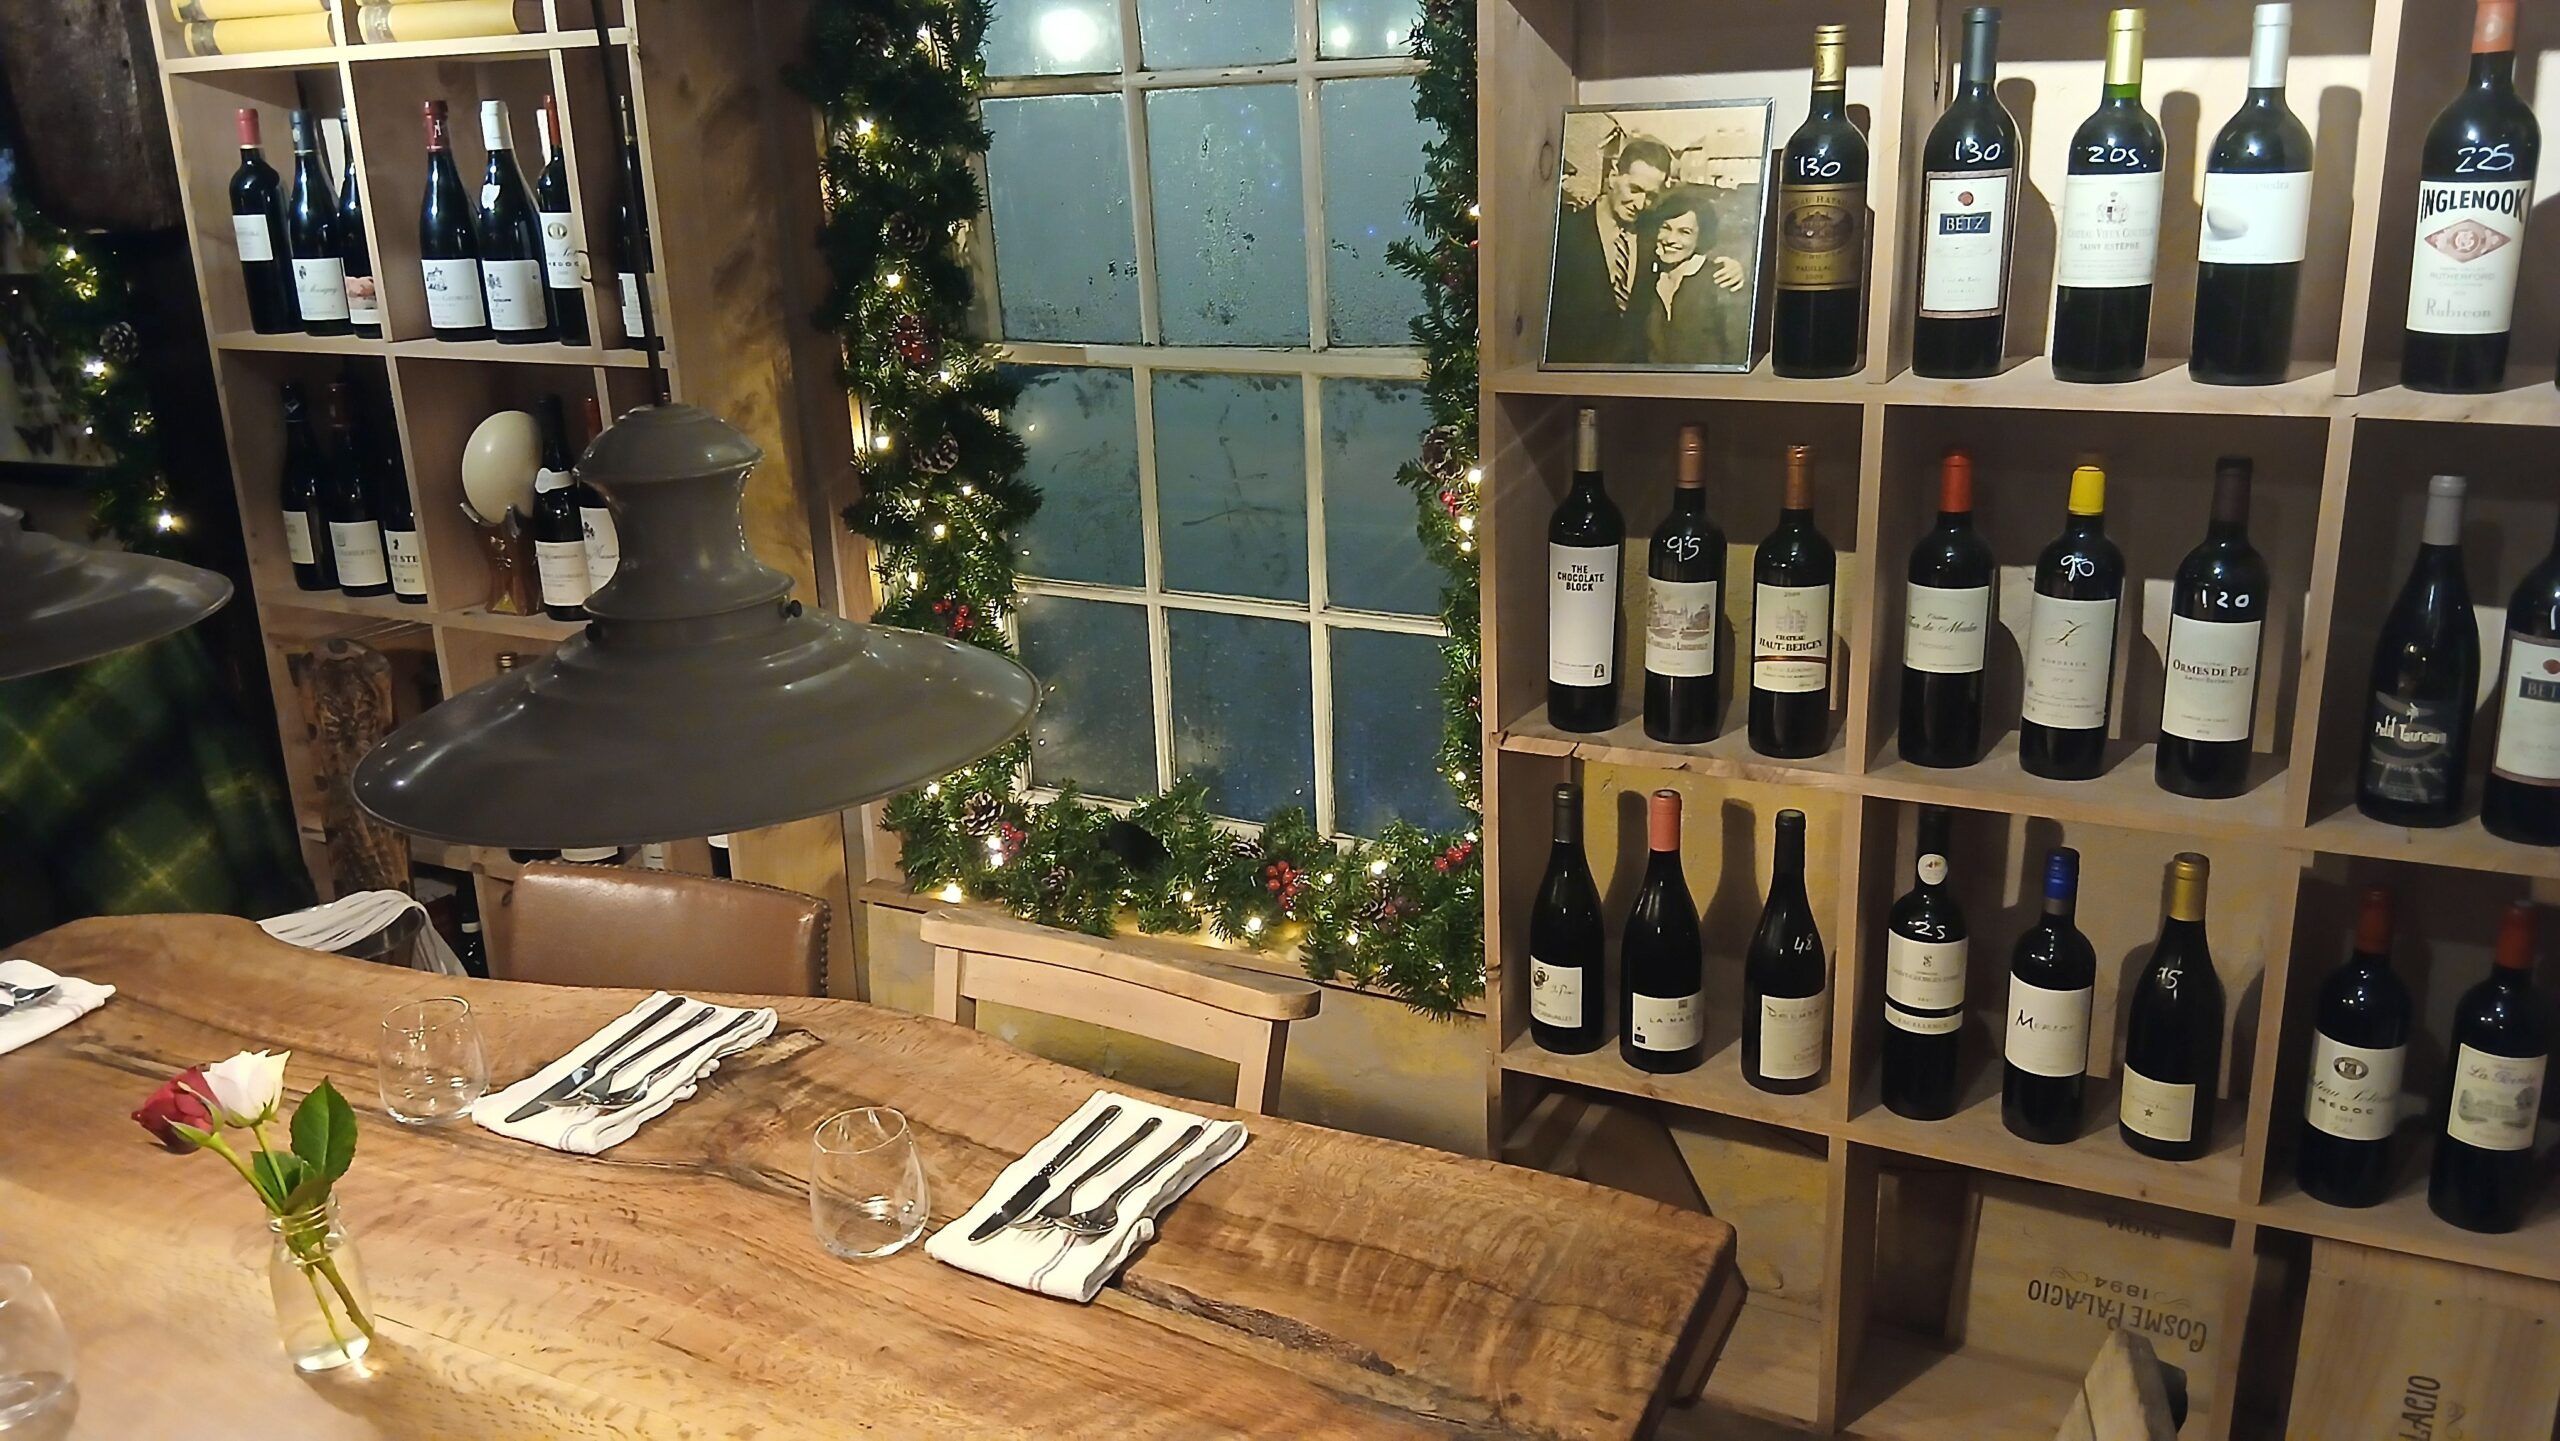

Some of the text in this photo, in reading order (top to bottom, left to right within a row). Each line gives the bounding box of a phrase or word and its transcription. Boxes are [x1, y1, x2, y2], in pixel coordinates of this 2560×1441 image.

[1955, 140, 2000, 163] 130
[2455, 143, 2515, 173] 225
[1799, 155, 1841, 177] 130
[2419, 187, 2528, 224] INGLENOOK
[1666, 535, 1702, 562] 95
[1557, 571, 1605, 583] CHOCOLATE
[1571, 564, 1589, 574] THE
[2060, 554, 2095, 583] 90
[1565, 581, 1594, 592] BLOCK
[2201, 589, 2250, 608] 120
[1759, 637, 1823, 652] HAUT-BERGEY
[2172, 658, 2250, 678] ORMES DE PEZ
[2105, 1217, 2162, 1240] RIOJA
[2094, 1276, 2148, 1300] 1894
[2027, 1279, 2208, 1353] COSME PALACIO
